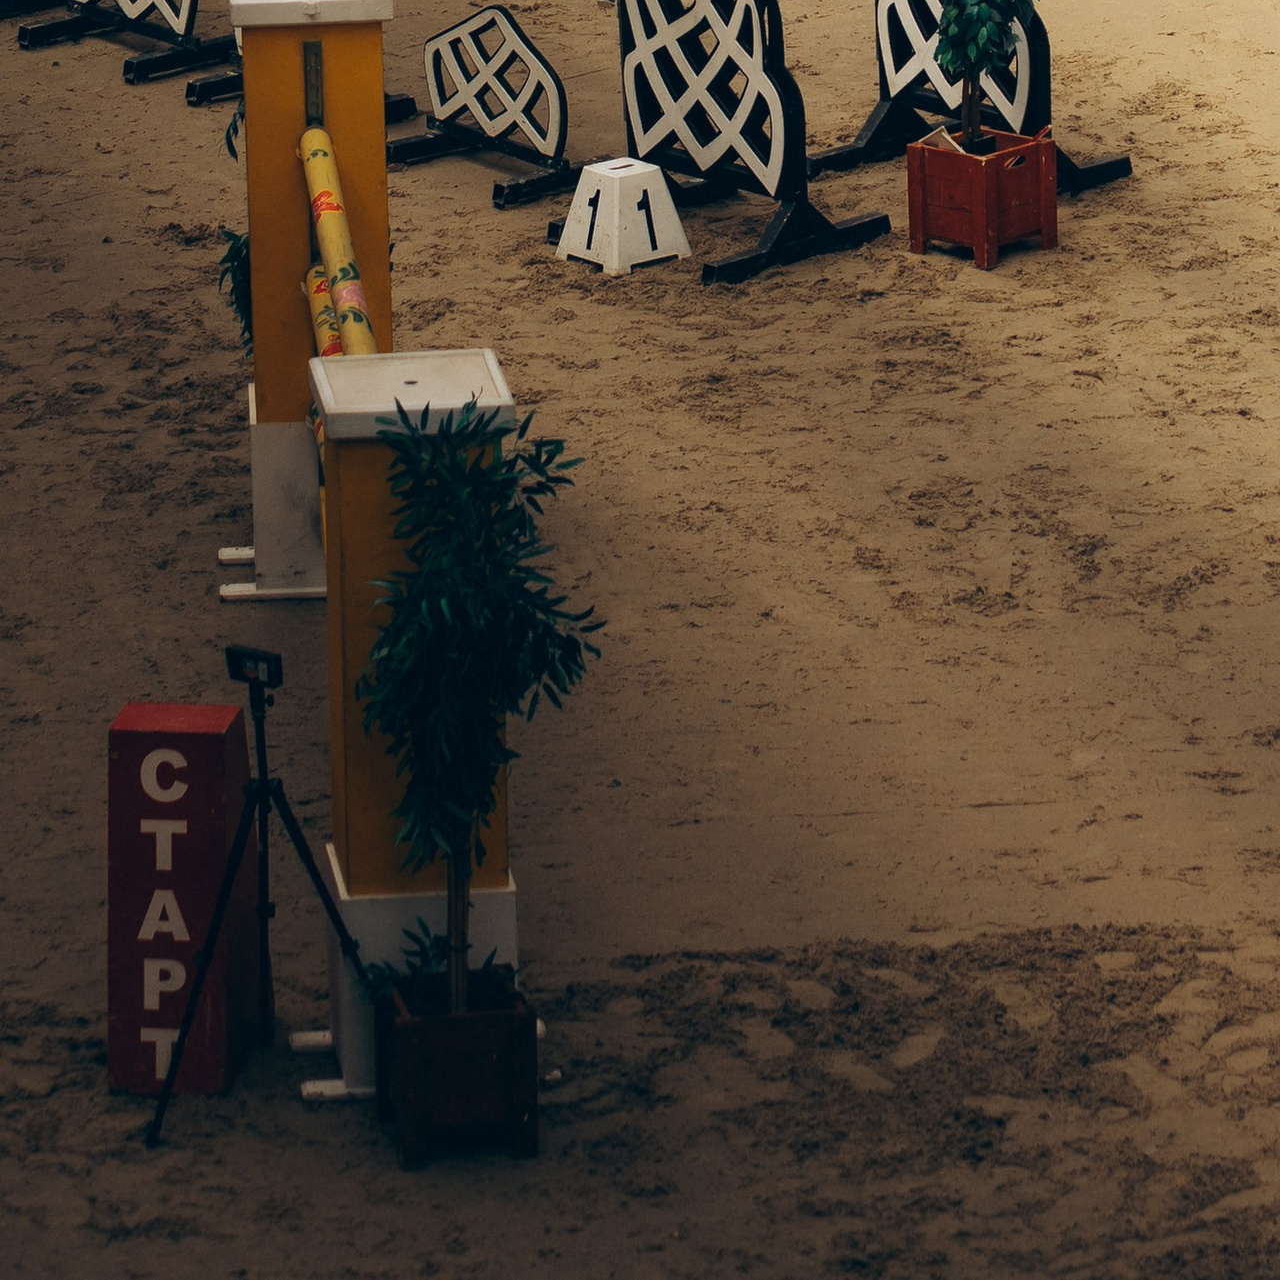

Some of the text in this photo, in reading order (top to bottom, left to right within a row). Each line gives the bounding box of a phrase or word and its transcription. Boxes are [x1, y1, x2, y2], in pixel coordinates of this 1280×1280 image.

[586, 189, 601, 250] 1
[637, 189, 658, 251] 1
[136, 748, 191, 1081] СТАРТ
